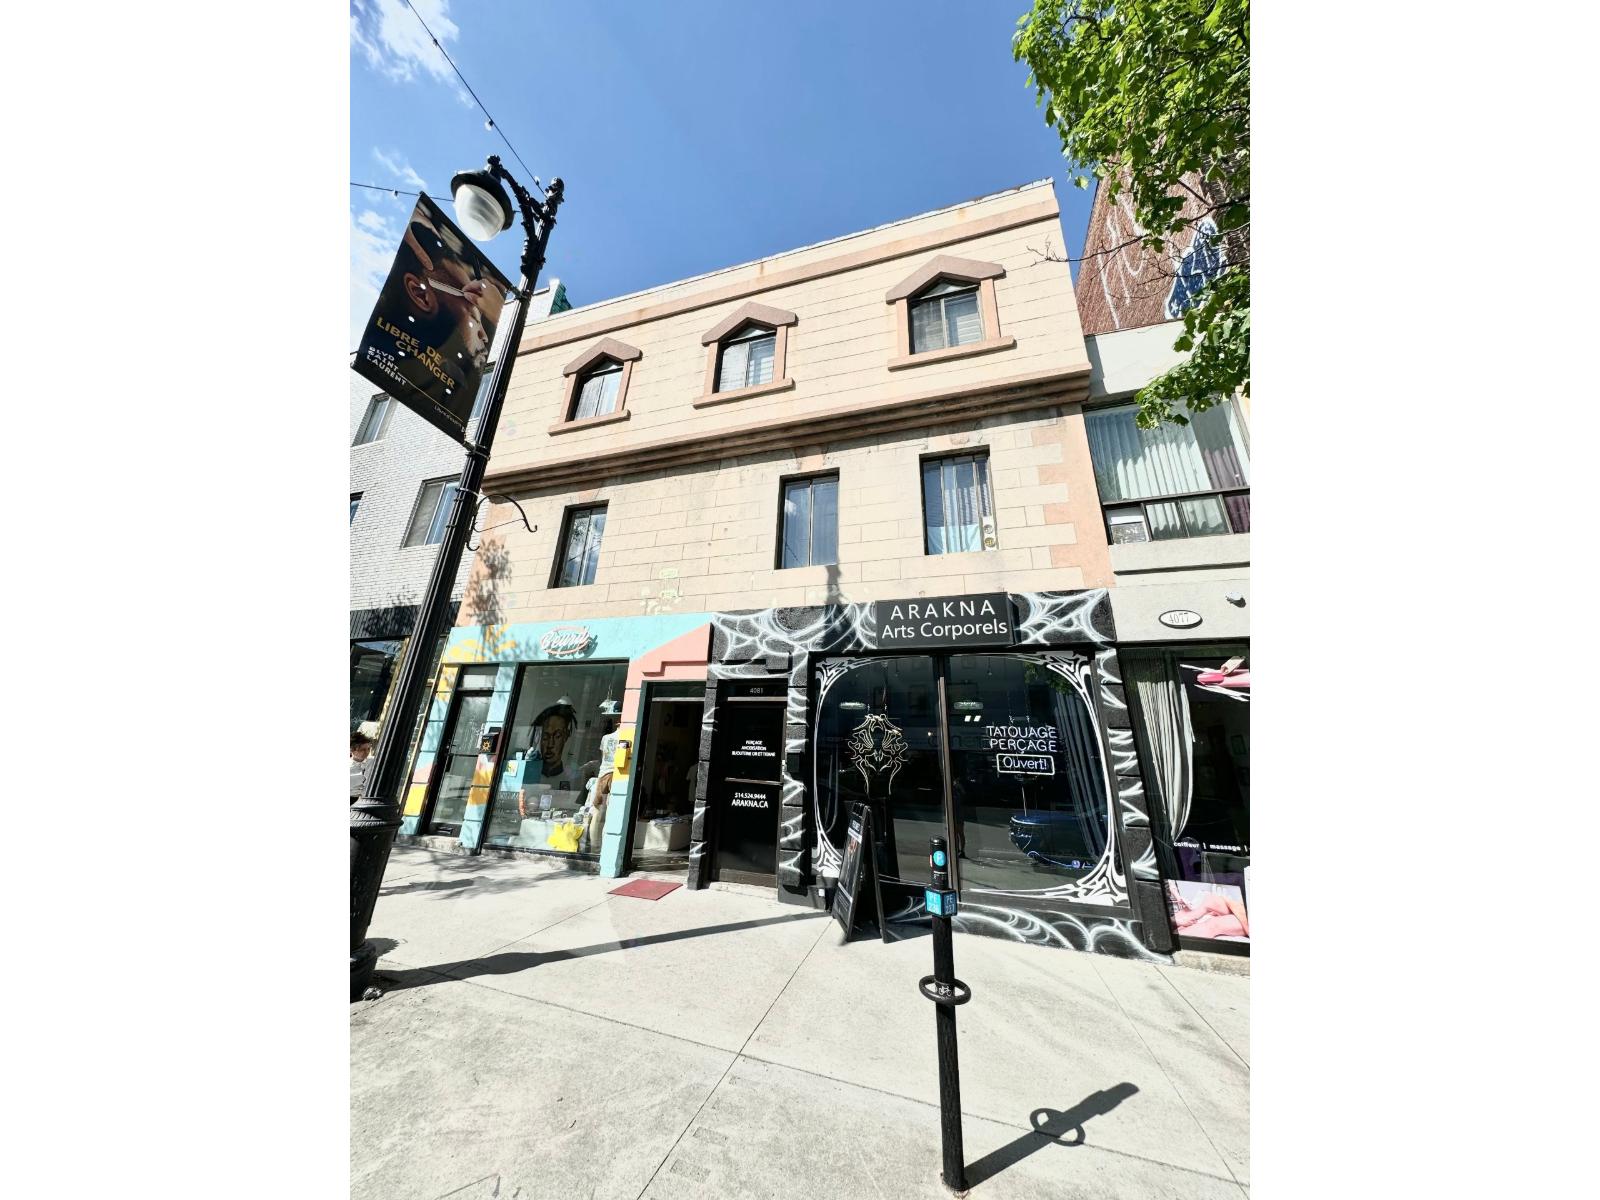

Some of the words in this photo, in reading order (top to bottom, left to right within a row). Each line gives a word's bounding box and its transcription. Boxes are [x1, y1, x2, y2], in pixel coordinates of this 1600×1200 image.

[376, 316, 420, 347] LIBRE
[426, 345, 442, 366] DE
[367, 350, 399, 371] SAINT
[369, 346, 395, 361] BLVD
[366, 354, 407, 386] LAURENT
[395, 340, 455, 389] CHANGER
[890, 600, 996, 620] ARAKNA
[1169, 612, 1189, 624] 4077
[881, 624, 915, 639] Arts
[920, 618, 1008, 640] Corporels
[986, 725, 1058, 739] TATOUAGE
[989, 738, 1058, 754] PERÇAGE
[1003, 756, 1047, 770] Ouvert!
[734, 792, 766, 800] 514.524.9444
[731, 799, 769, 809] ARAKNA.CA
[1173, 841, 1200, 849] coiffeur
[1209, 843, 1241, 851] massage
